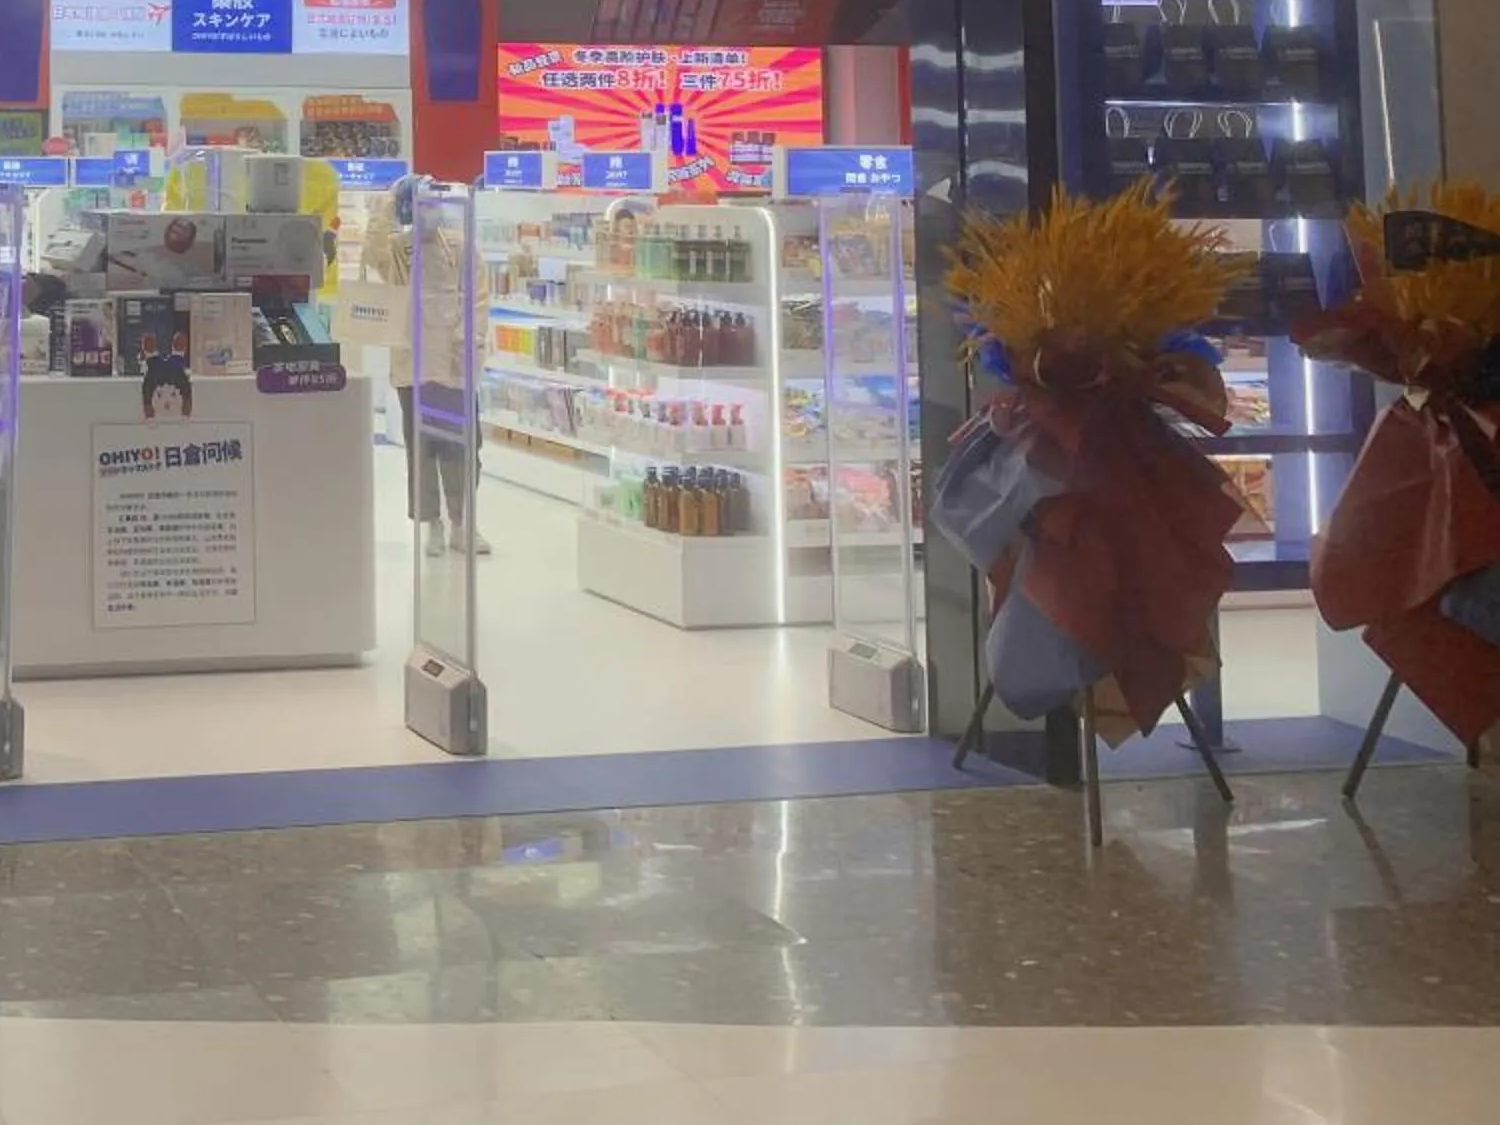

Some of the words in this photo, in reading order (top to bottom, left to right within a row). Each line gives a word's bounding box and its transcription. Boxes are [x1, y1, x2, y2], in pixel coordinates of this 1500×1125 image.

[192, 12, 271, 28] スキンケア
[99, 446, 160, 466] OHIYO!
